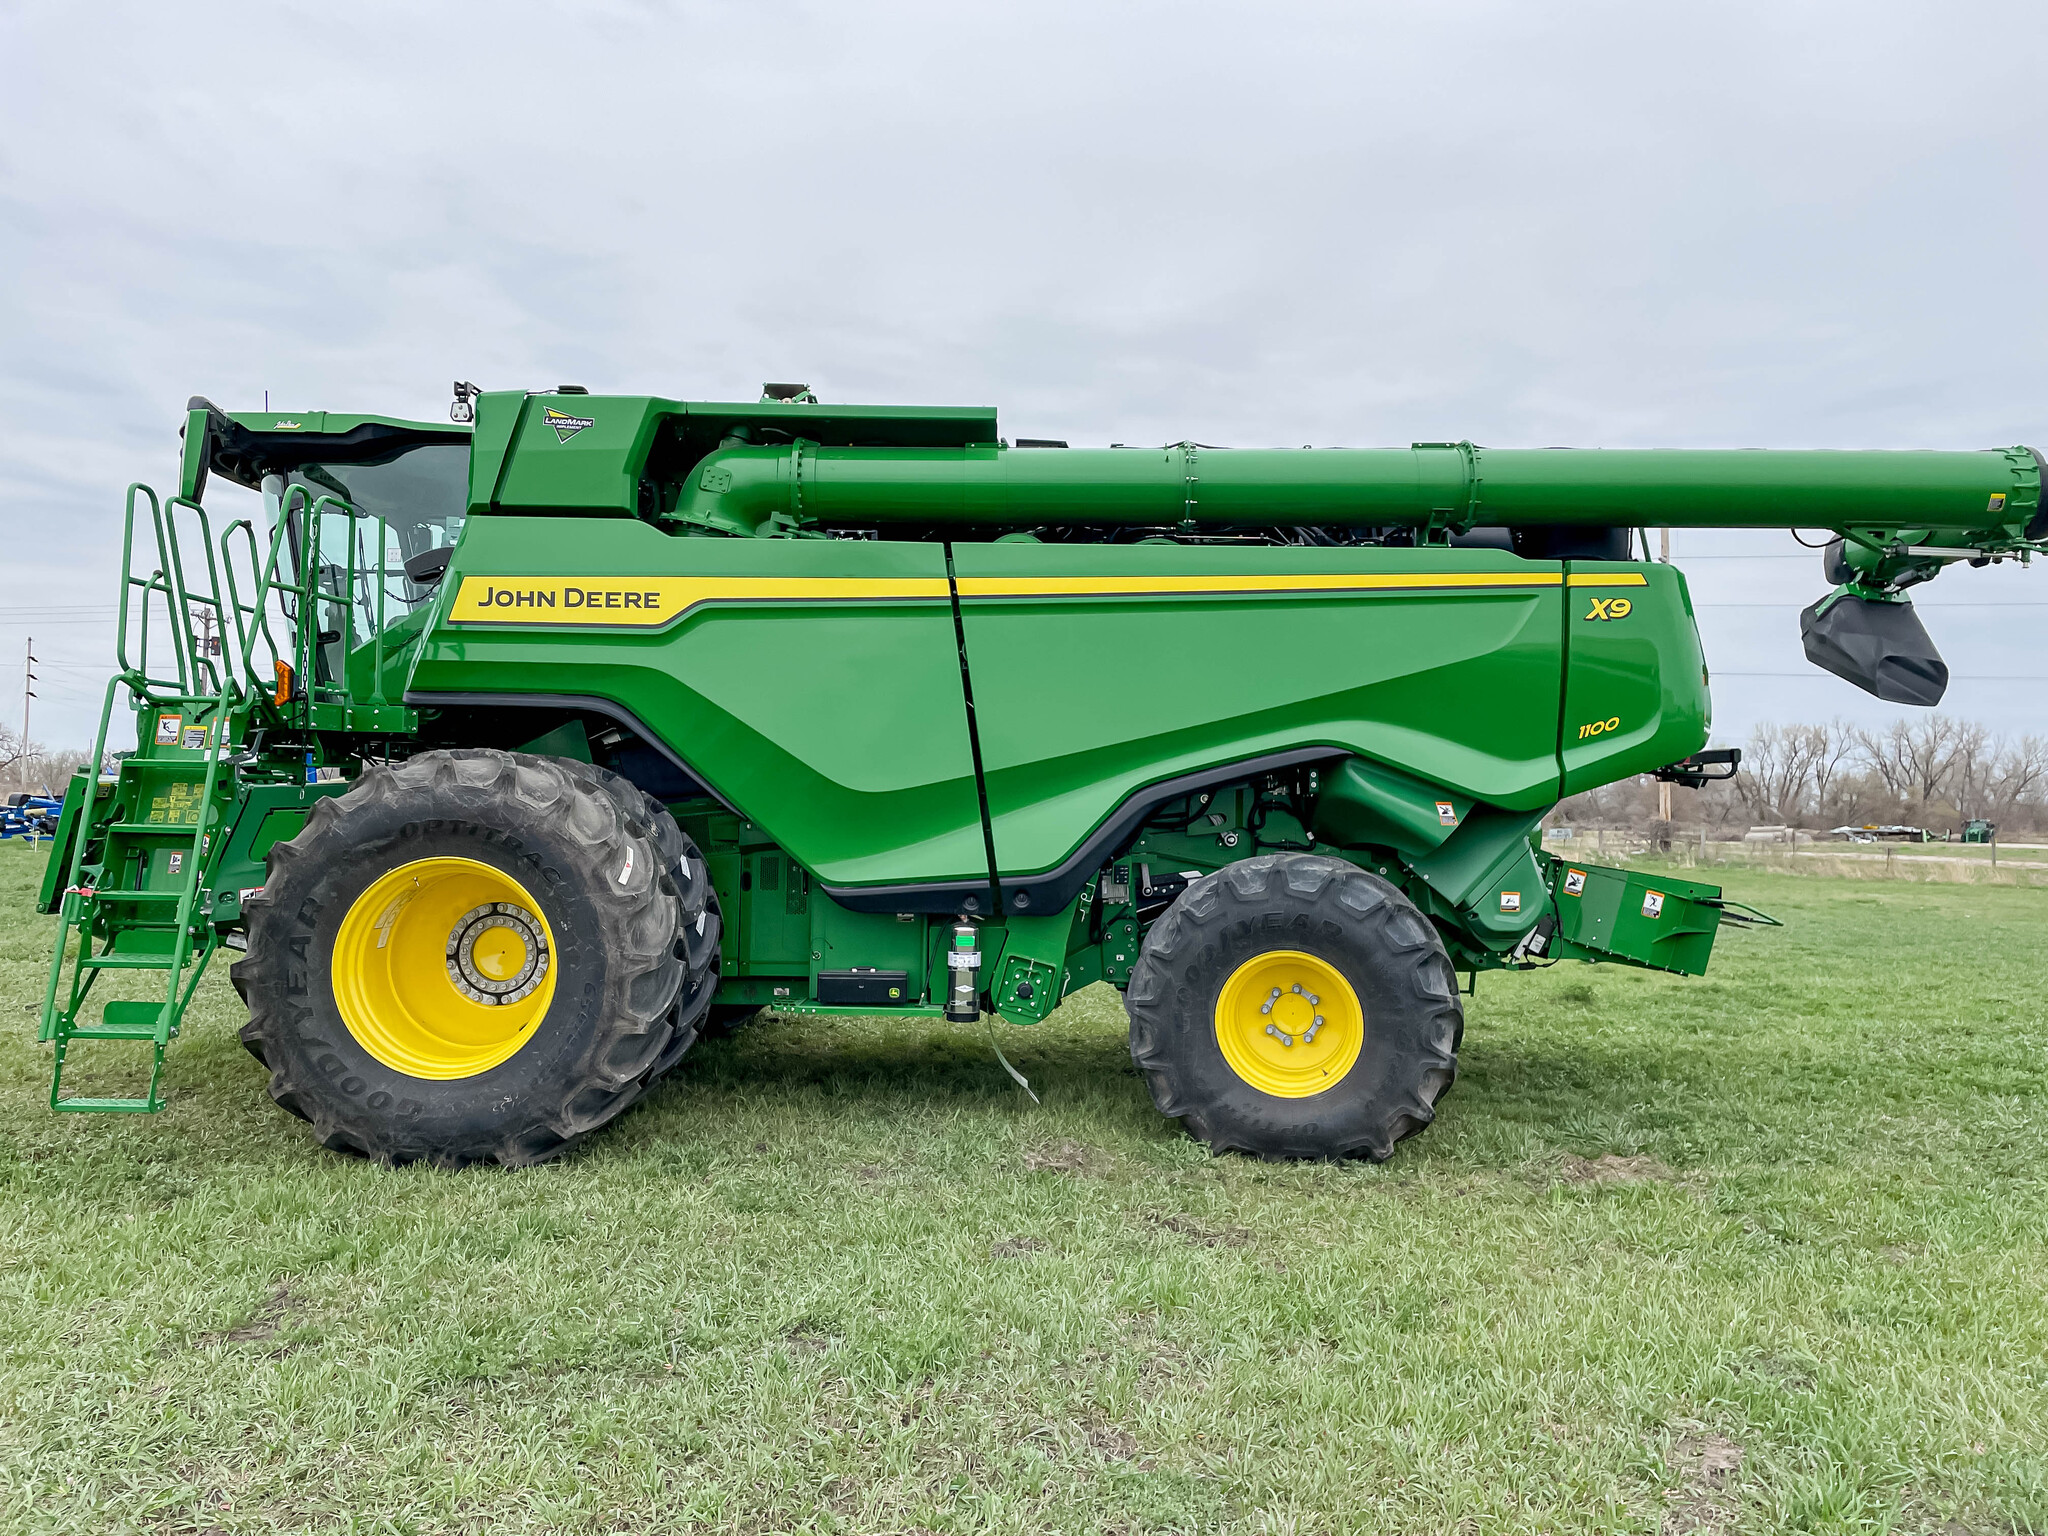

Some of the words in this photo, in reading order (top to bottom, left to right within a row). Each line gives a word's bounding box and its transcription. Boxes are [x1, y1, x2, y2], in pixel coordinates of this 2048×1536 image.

[545, 418, 593, 426] LANDMARK
[478, 586, 556, 608] JOHN
[564, 587, 662, 609] DEERE
[1583, 598, 1633, 622] X9
[1578, 716, 1621, 740] 1100
